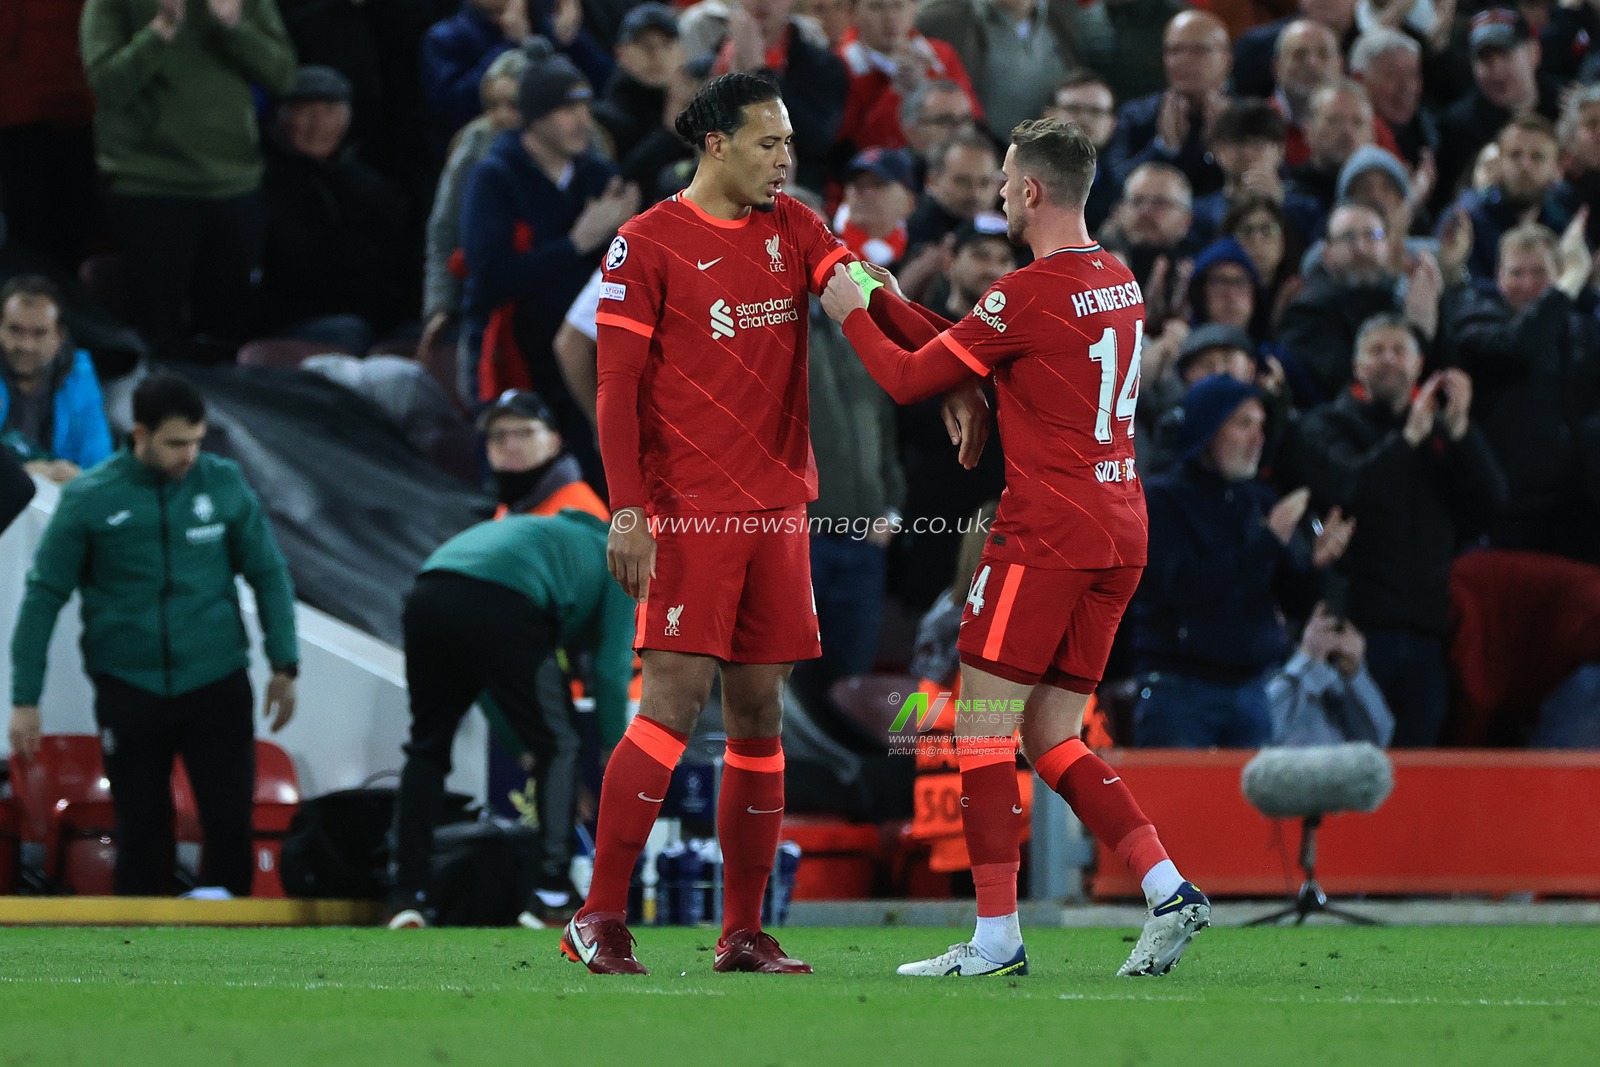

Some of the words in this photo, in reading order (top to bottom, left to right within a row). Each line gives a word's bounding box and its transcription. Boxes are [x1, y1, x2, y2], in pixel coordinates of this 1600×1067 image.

[735, 295, 794, 317] standard
[1071, 281, 1144, 317] HENDERSO
[738, 308, 799, 330] chartered
[972, 303, 1008, 333] pedia
[1088, 319, 1144, 444] 14
[966, 565, 991, 617] 4
